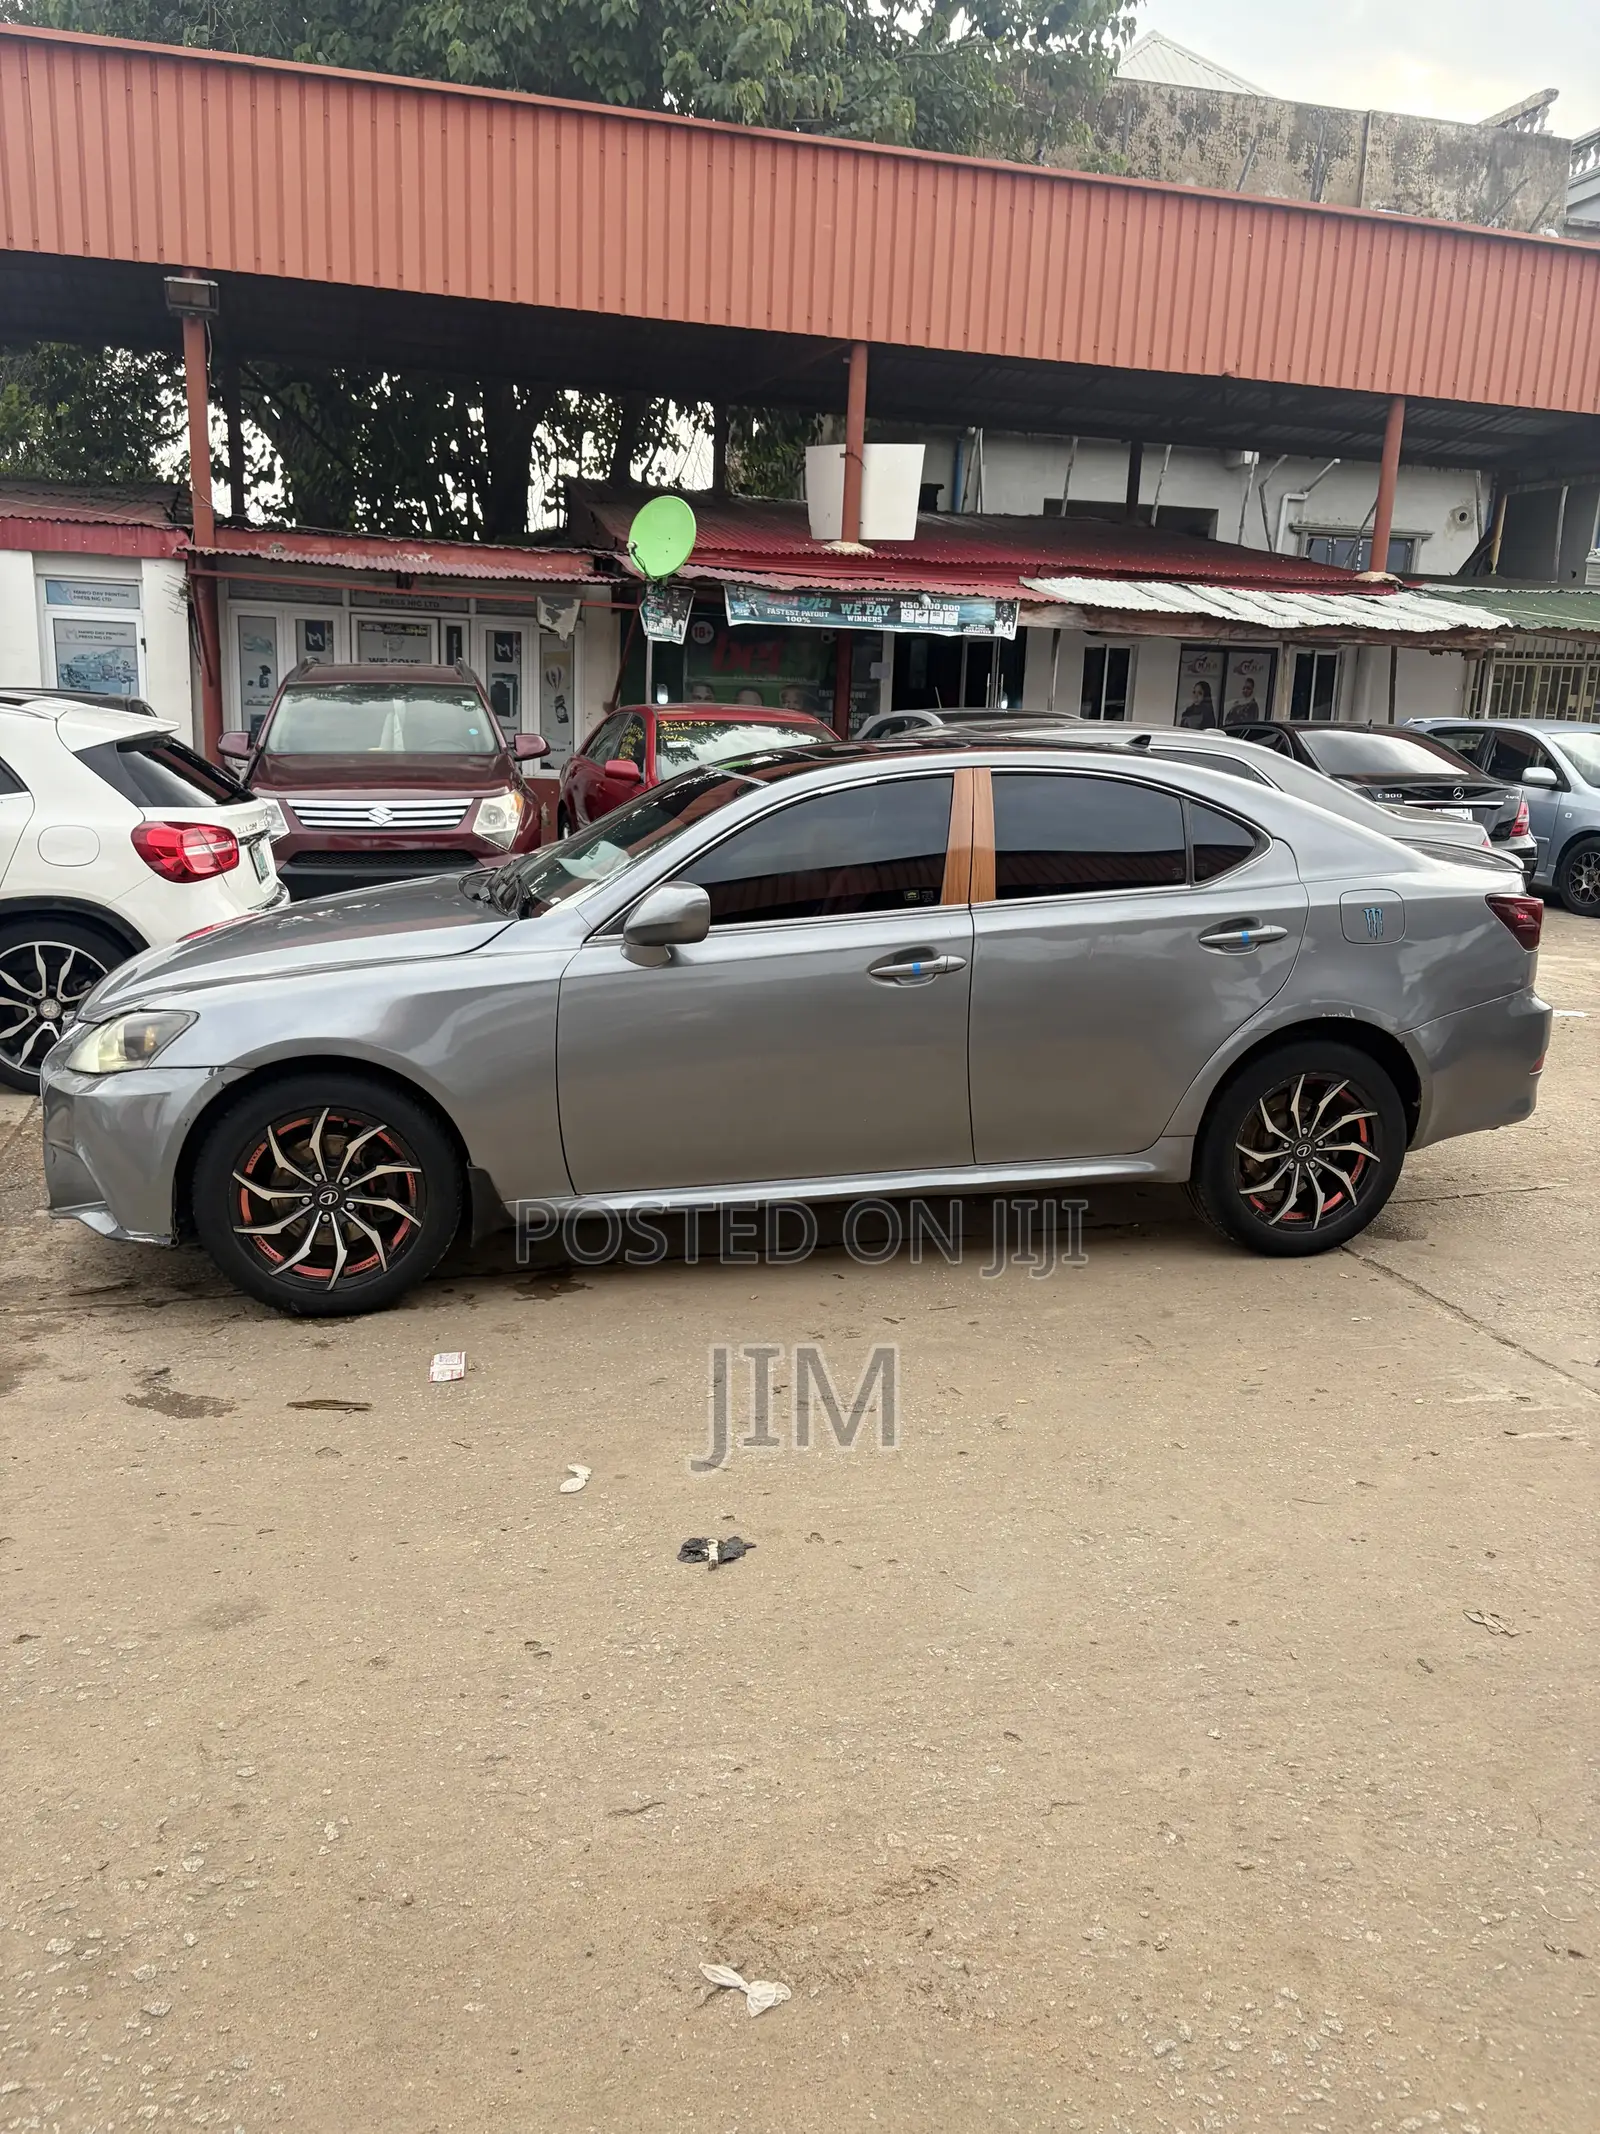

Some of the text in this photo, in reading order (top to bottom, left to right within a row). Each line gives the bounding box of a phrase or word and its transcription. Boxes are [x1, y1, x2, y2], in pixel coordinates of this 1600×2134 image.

[766, 607, 800, 616] FASTEST
[840, 603, 891, 616] WE PAY
[847, 615, 883, 623] WINNERS
[693, 626, 712, 638] 18+
